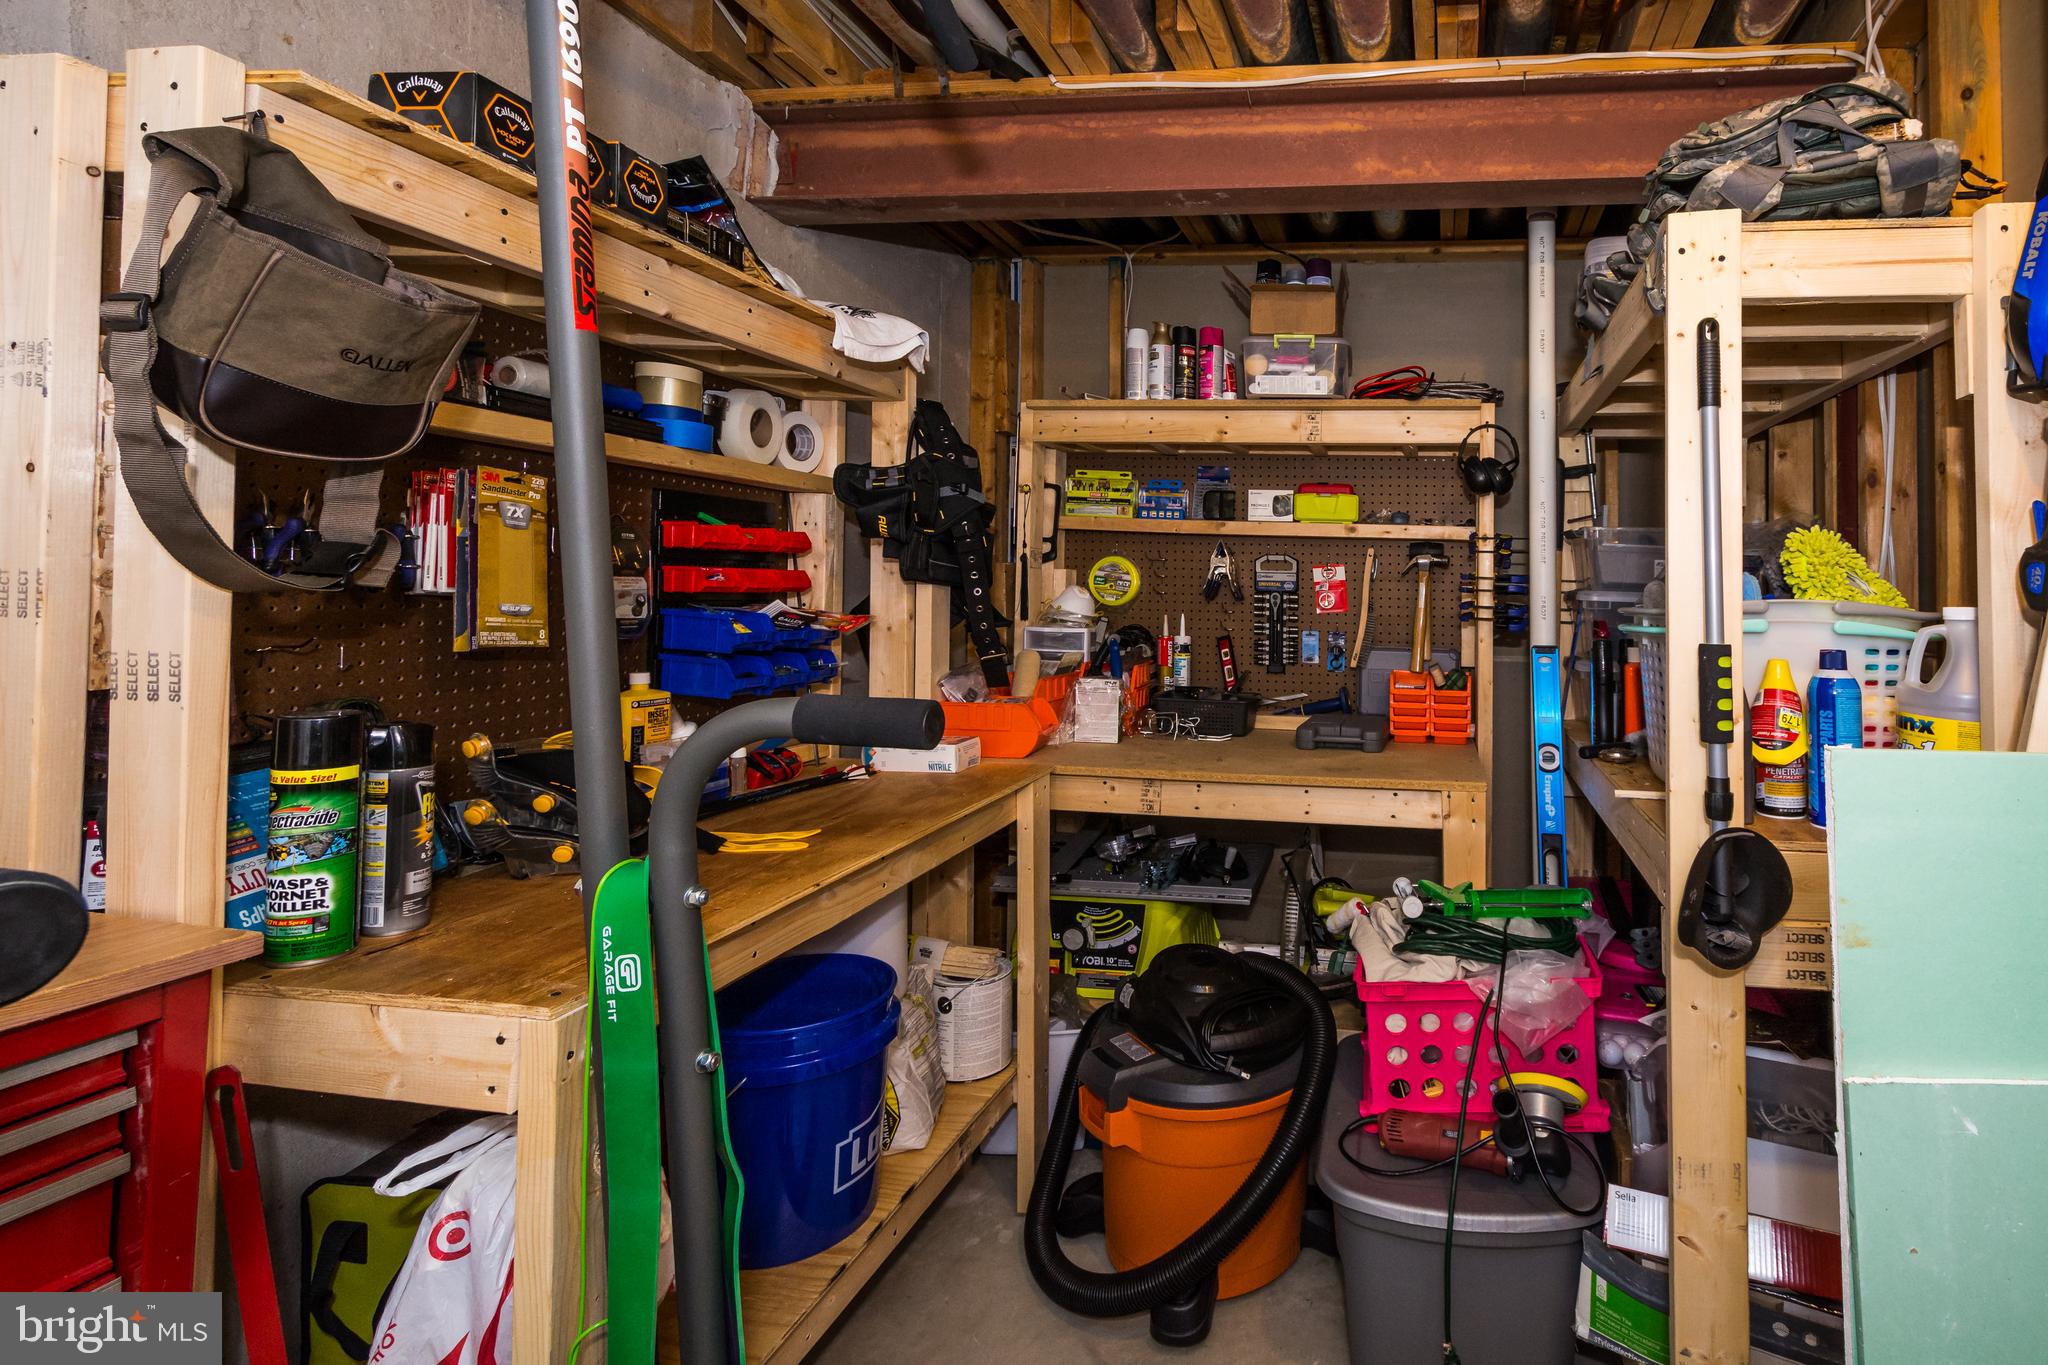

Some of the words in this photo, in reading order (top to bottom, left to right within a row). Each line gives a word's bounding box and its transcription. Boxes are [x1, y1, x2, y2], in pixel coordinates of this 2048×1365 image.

[558, 0, 583, 89] 1690
[396, 75, 444, 94] Callaway
[494, 105, 531, 133] Callaway
[564, 97, 588, 156] PT
[630, 183, 658, 204] Callaway
[2022, 211, 2048, 279] KOBALT
[481, 470, 500, 484] 3M
[531, 477, 545, 486] 220
[481, 483, 528, 497] SandBlaster
[528, 491, 541, 500] Pro
[506, 505, 525, 519] 7X
[0, 570, 10, 618] SELECT
[17, 569, 28, 618] SELECT
[539, 629, 546, 639] 8
[127, 651, 139, 701] SELECT
[147, 651, 160, 702] SELECT
[169, 651, 182, 703] SELECT
[1781, 712, 1801, 728] 1.79
[1820, 710, 1834, 746] PARTS
[928, 763, 952, 772] NITRILE
[280, 775, 307, 785] Value
[310, 773, 338, 783] Size!
[1543, 774, 1556, 817] Empire
[270, 810, 340, 830] ectracide
[226, 866, 267, 897] UTY
[267, 877, 315, 891] WASP
[315, 876, 329, 887] &
[239, 903, 266, 928] APS
[269, 899, 330, 913] KILLER.
[288, 919, 308, 927] Spray
[1786, 932, 1825, 944] SELECT
[602, 925, 615, 995] GARAGE
[1082, 956, 1105, 966] YOBI
[1785, 951, 1826, 963] SELECT
[1785, 969, 1827, 982] SELECT
[607, 999, 617, 1023] FIT
